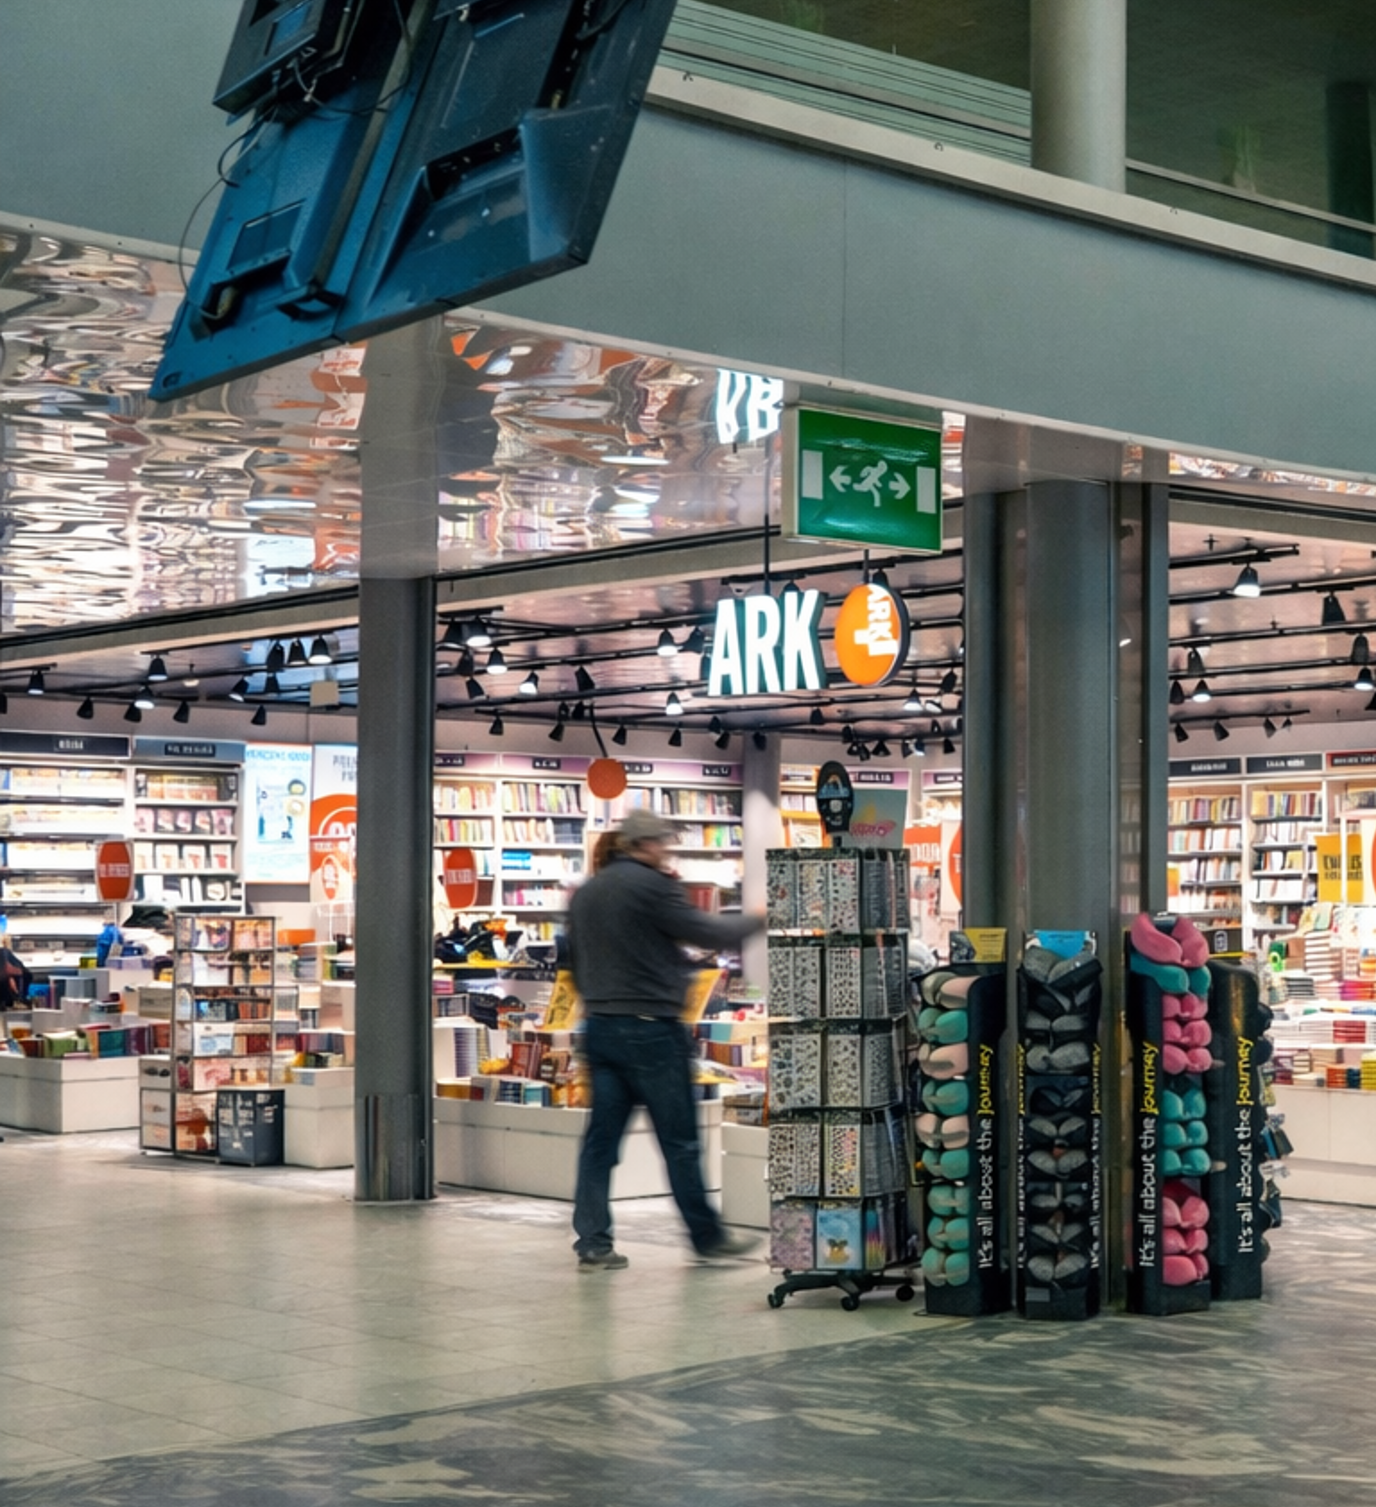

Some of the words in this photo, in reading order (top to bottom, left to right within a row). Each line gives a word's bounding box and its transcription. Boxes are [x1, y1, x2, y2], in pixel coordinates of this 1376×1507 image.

[708, 589, 821, 696] ARK
[976, 1118, 993, 1151] the
[1139, 1117, 1156, 1149] the
[1235, 1108, 1252, 1140] the
[978, 1155, 993, 1210] about
[1140, 1154, 1156, 1210] about
[1236, 1142, 1253, 1198] about
[976, 1217, 993, 1236] all
[1138, 1214, 1156, 1235] all
[1236, 1202, 1253, 1229] all
